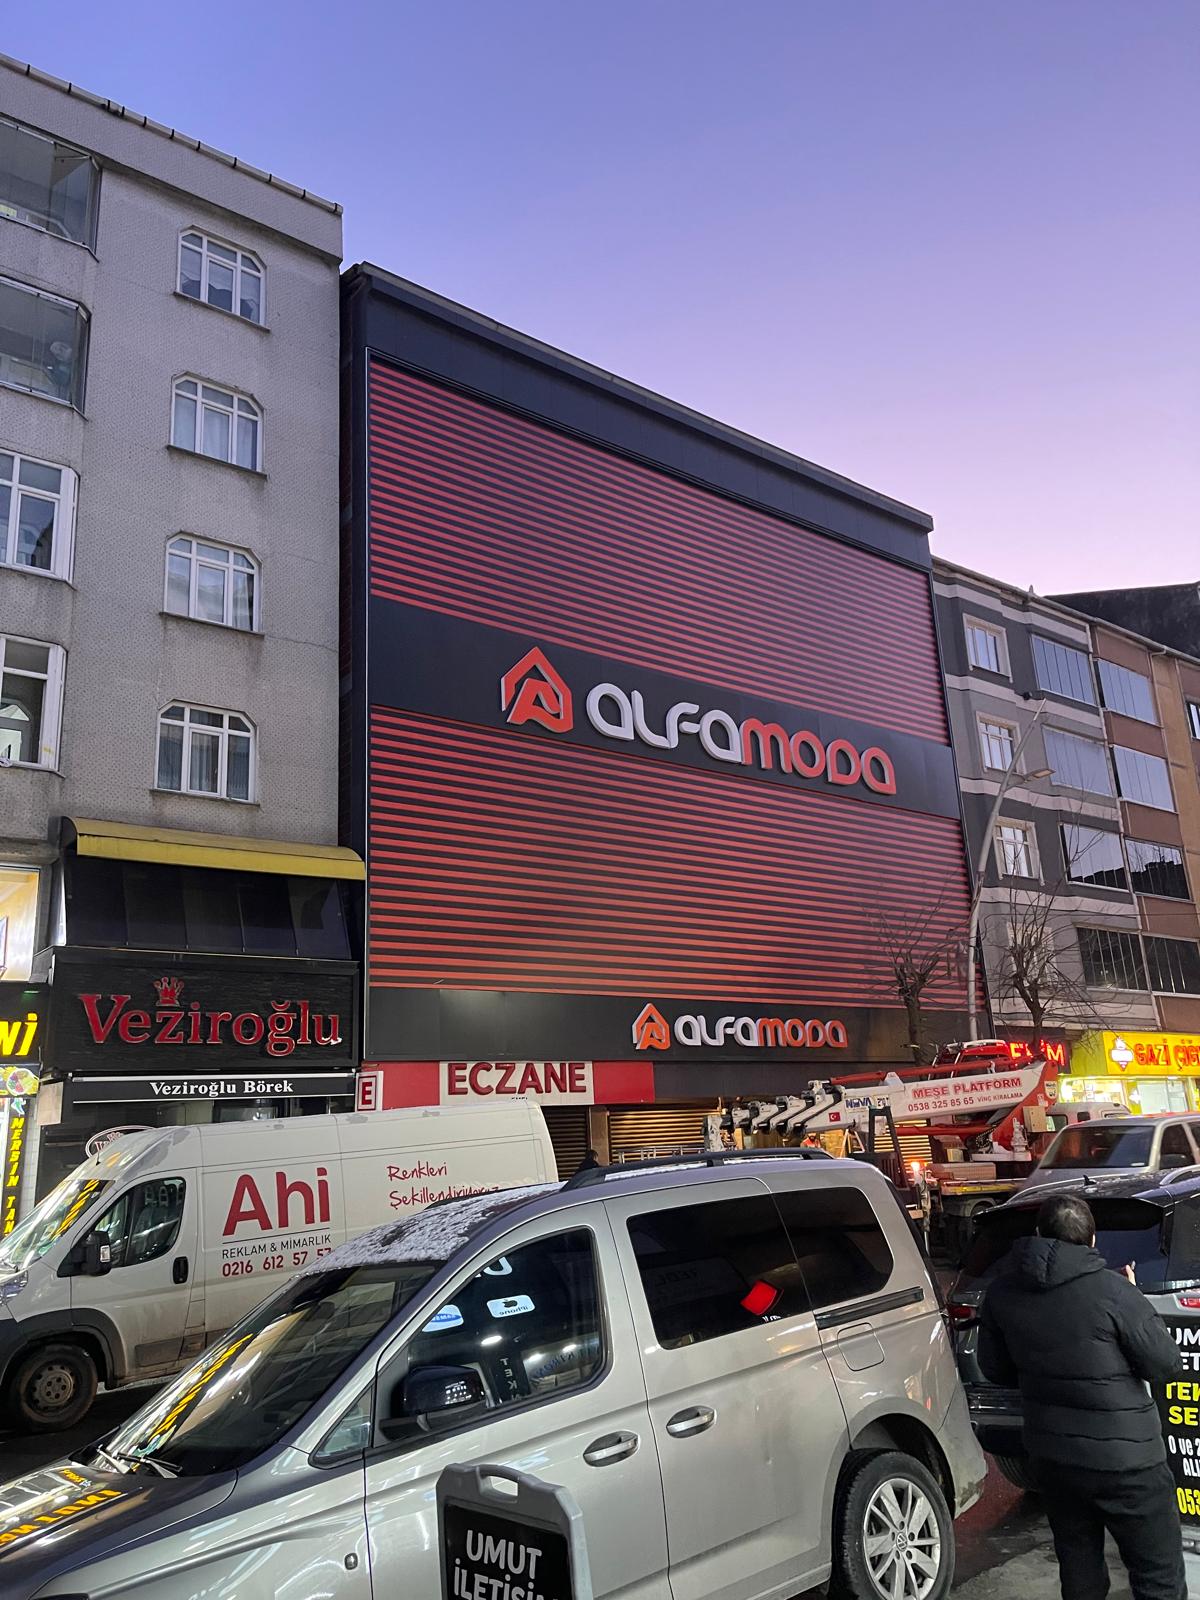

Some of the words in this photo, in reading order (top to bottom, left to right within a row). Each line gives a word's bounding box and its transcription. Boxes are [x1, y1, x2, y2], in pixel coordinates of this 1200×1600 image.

[80, 994, 342, 1056] Veziroğlu
[1134, 1039, 1171, 1066] GAZİ
[1173, 1039, 1200, 1071] ÇİĞ
[150, 1081, 237, 1097] Veziroğlu
[243, 1080, 294, 1093] Börek
[448, 1061, 587, 1096] ECZANE
[954, 1078, 1022, 1094] PLATFORM
[361, 1082, 374, 1105] E
[908, 1102, 930, 1112] 0538
[932, 1100, 948, 1109] 325
[950, 1098, 961, 1107] 85
[963, 1097, 974, 1105] 65
[387, 1160, 447, 1181] Renkleri
[222, 1167, 330, 1236] Ahi
[389, 1186, 500, 1210] Şekillendiriyorz
[4, 1196, 16, 1237] TAN
[222, 1243, 267, 1260] REKLAM
[270, 1242, 277, 1253] &
[281, 1234, 332, 1251] MİMARLIK
[222, 1260, 253, 1277] 0216
[263, 1255, 284, 1271] 612
[292, 1251, 308, 1266] 57
[466, 1529, 542, 1580] UMUT
[454, 1558, 560, 1600] İLETİİ
